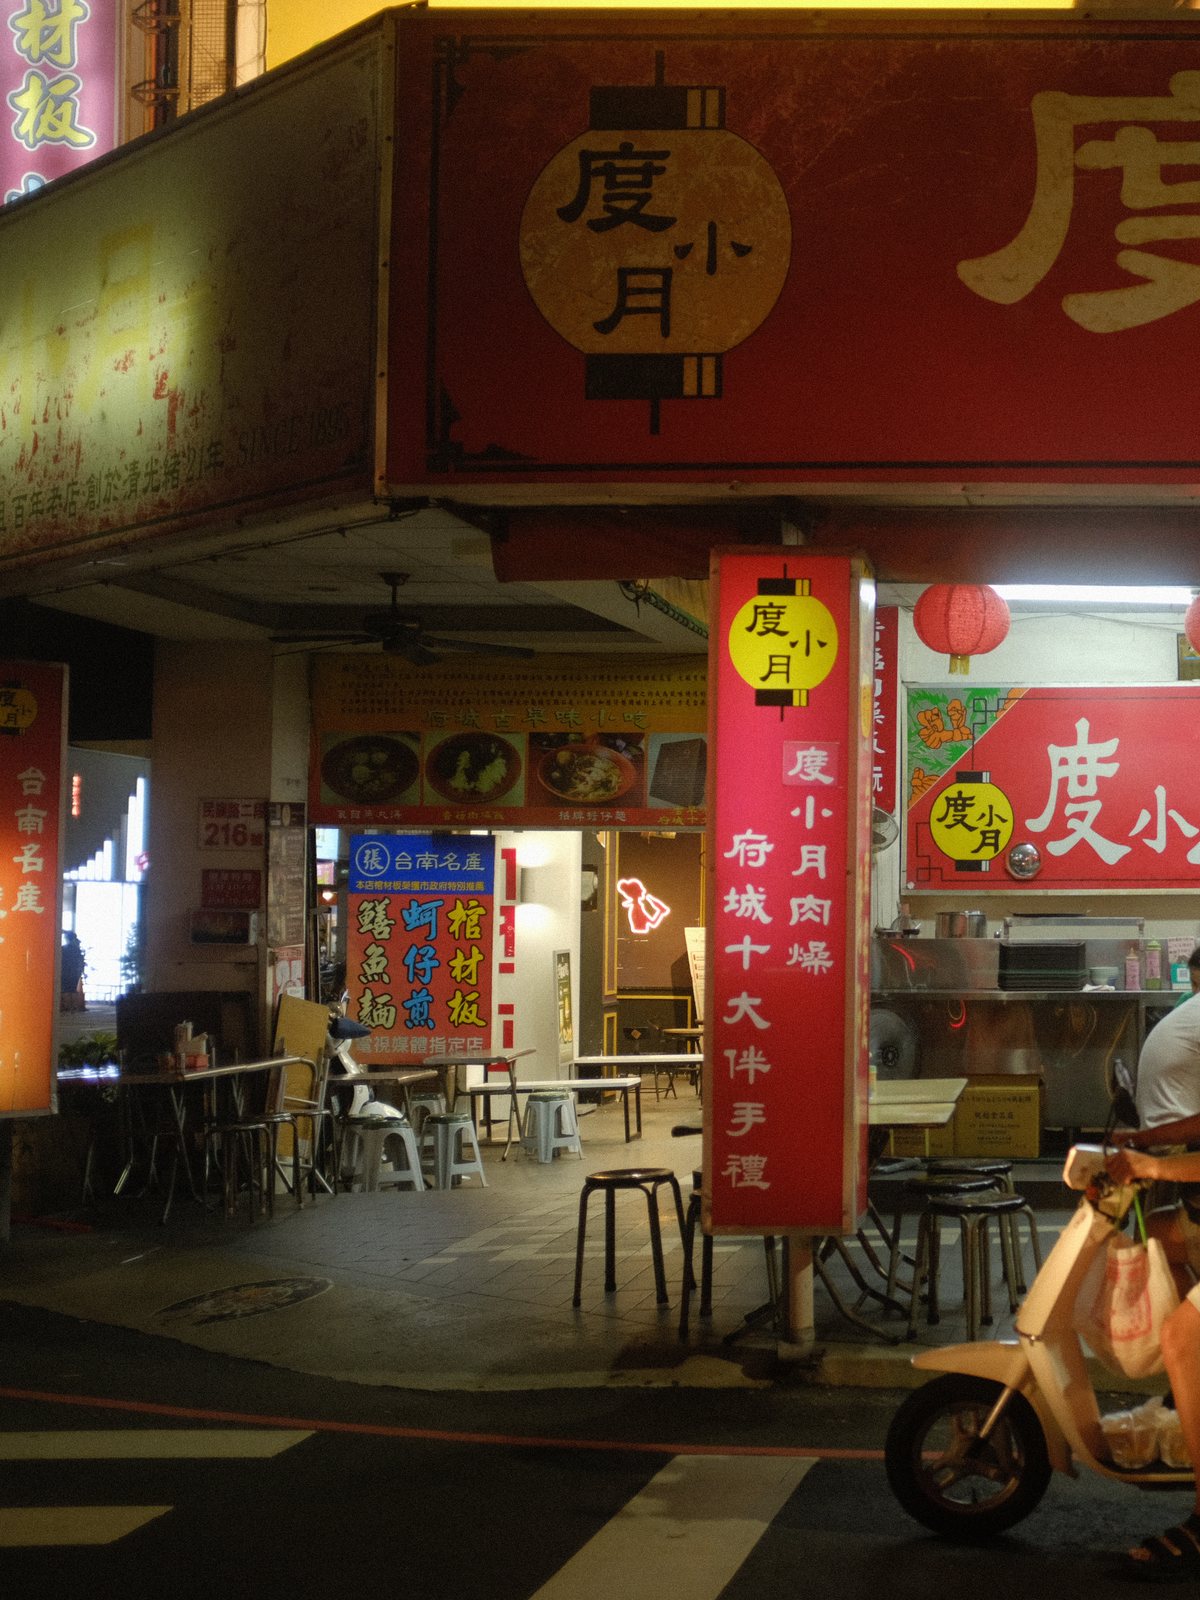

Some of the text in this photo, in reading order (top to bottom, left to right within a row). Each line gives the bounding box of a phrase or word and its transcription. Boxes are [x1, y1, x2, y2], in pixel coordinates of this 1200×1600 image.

[556, 140, 753, 339] 度小月
[745, 600, 829, 684] 度小月
[422, 708, 652, 731] 府城古早味小吃
[12, 767, 47, 914] 台南名產
[362, 848, 485, 871] 張 台南名產
[785, 745, 836, 977] 度小月肉燥
[936, 789, 1006, 855] 度小月
[356, 898, 396, 1030] 鱔魚麵
[401, 899, 444, 1030] 蚵仔煎
[446, 898, 488, 1029] 棺材板
[721, 829, 776, 1192] 府城十大伴手禮
